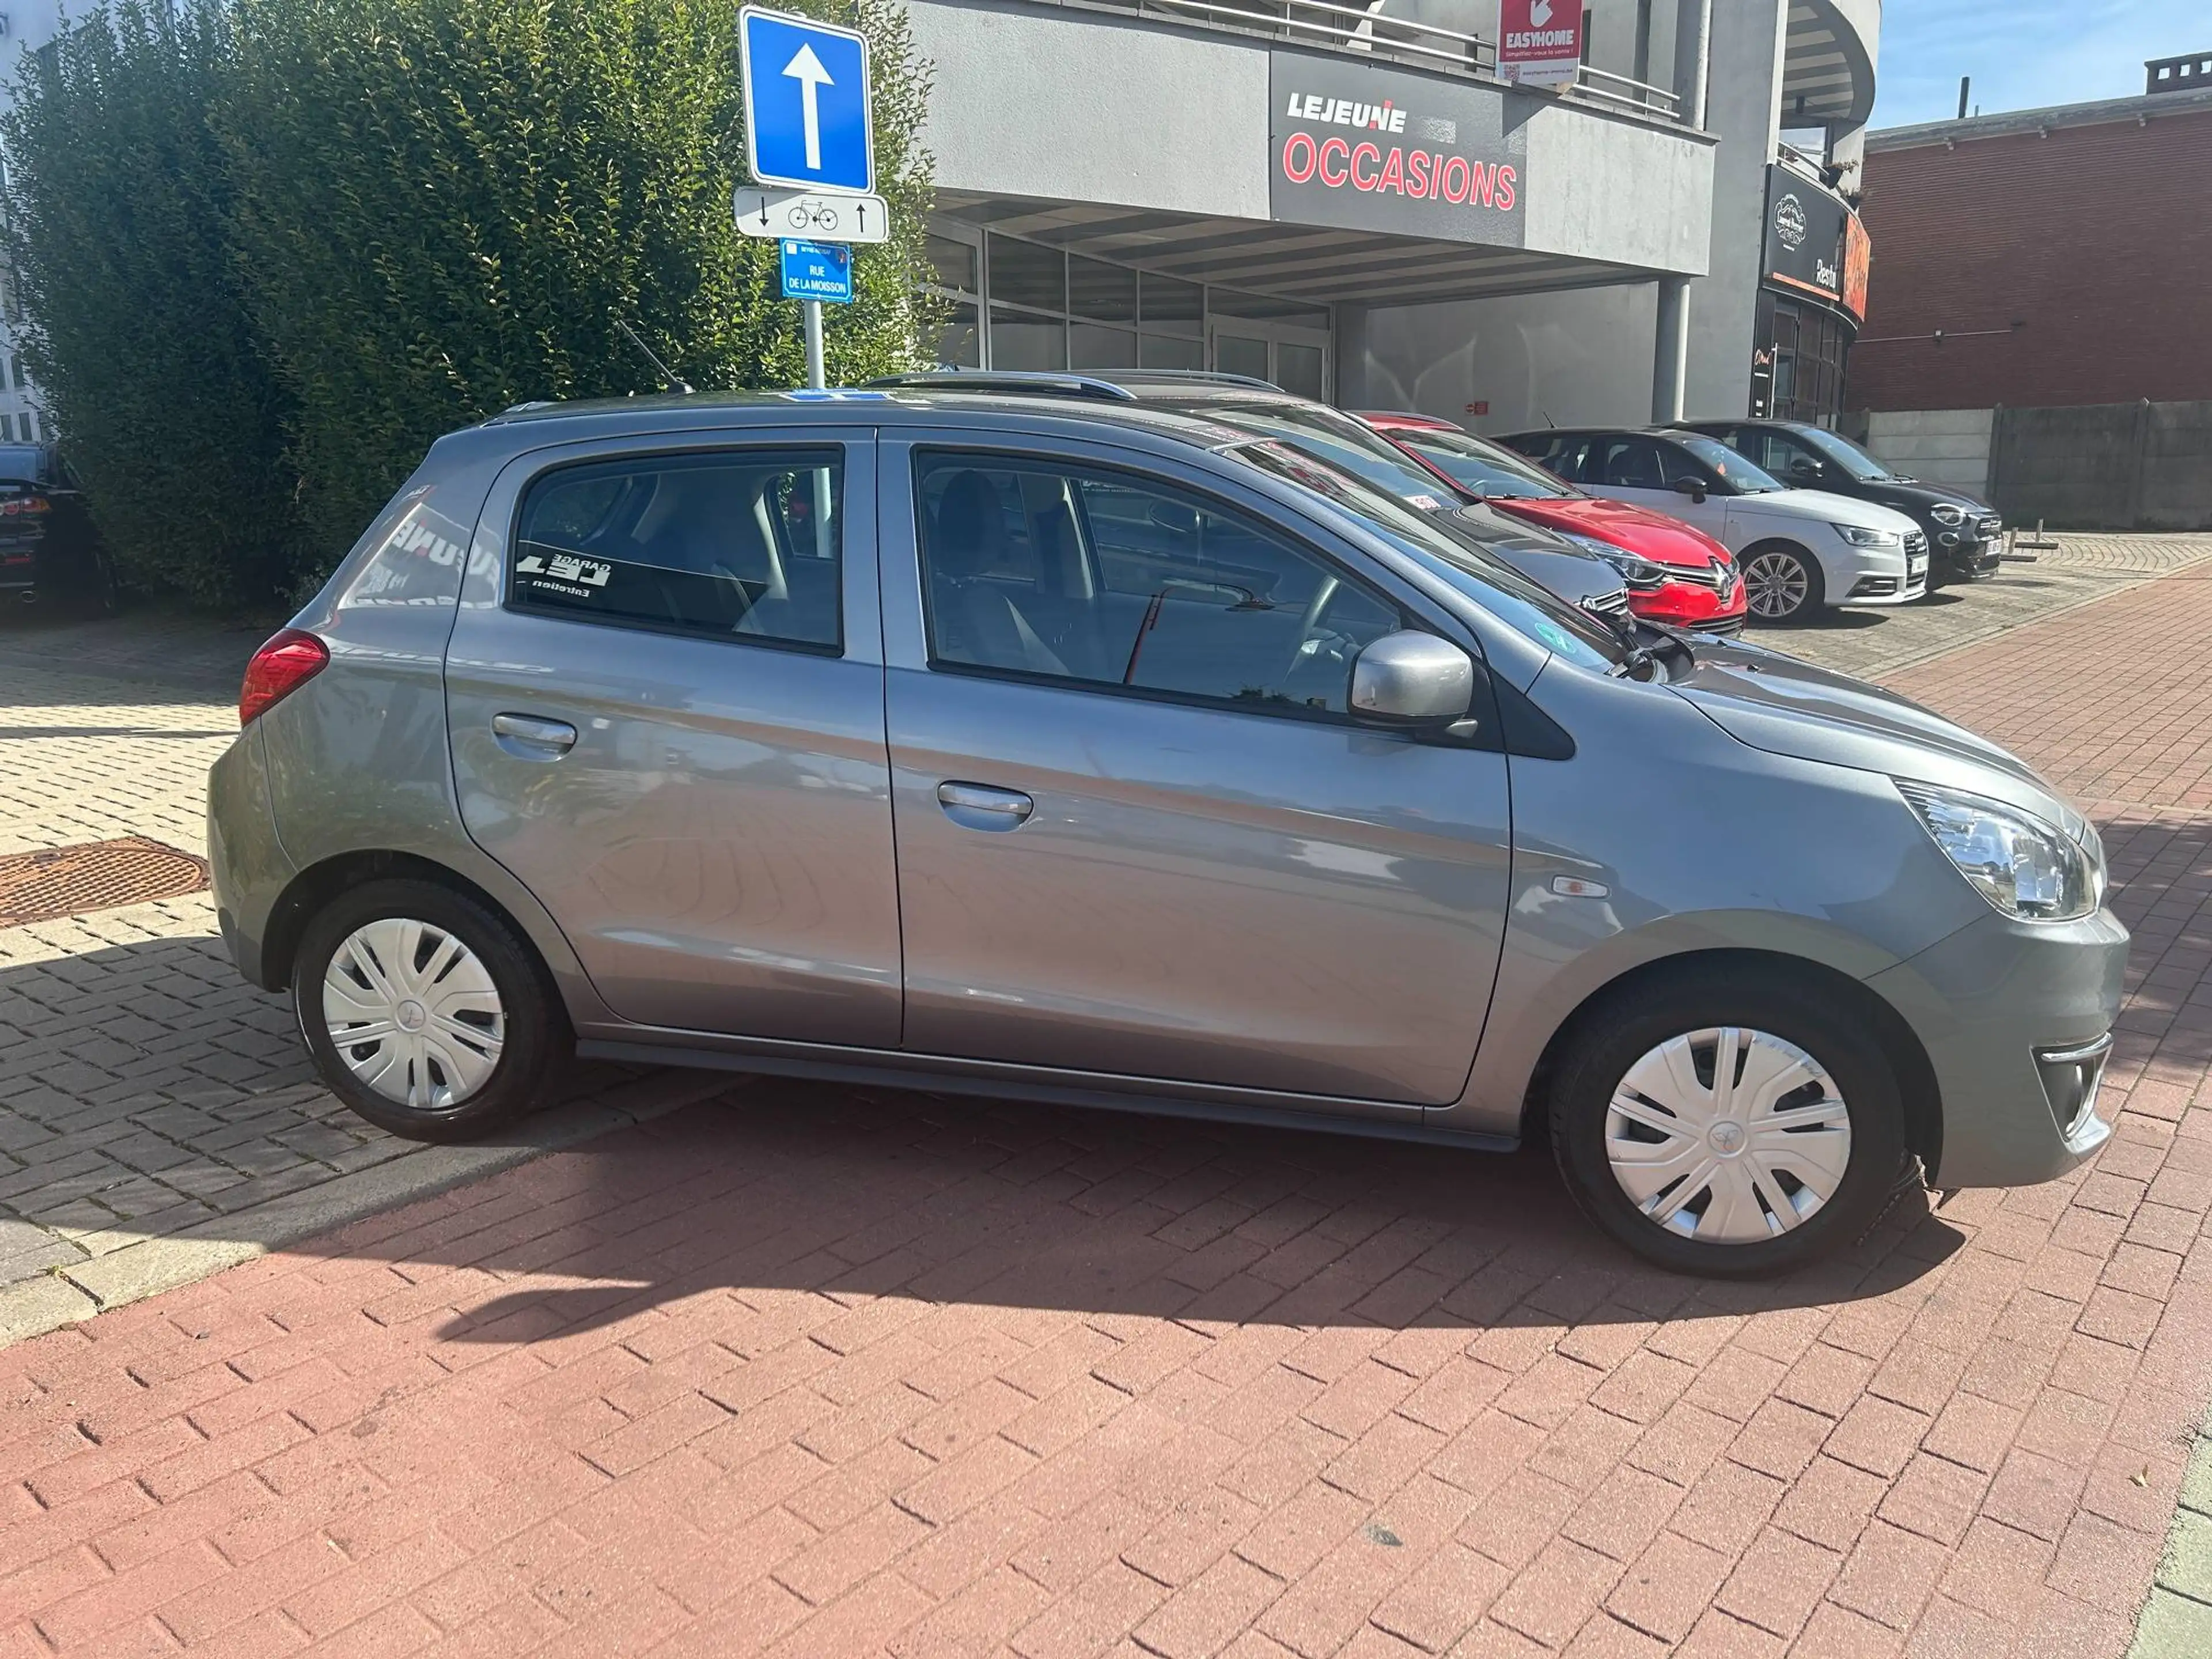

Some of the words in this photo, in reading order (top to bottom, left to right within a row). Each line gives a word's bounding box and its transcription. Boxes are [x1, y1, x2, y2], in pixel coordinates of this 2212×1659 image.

[1506, 29, 1574, 48] EASYHOME
[1286, 92, 1407, 134] LEJEUNE
[1282, 132, 1517, 212] OCCASIONS
[809, 264, 825, 277] RUE
[789, 277, 800, 288] DE
[800, 278, 810, 290] LA
[810, 280, 847, 294] MOISSON
